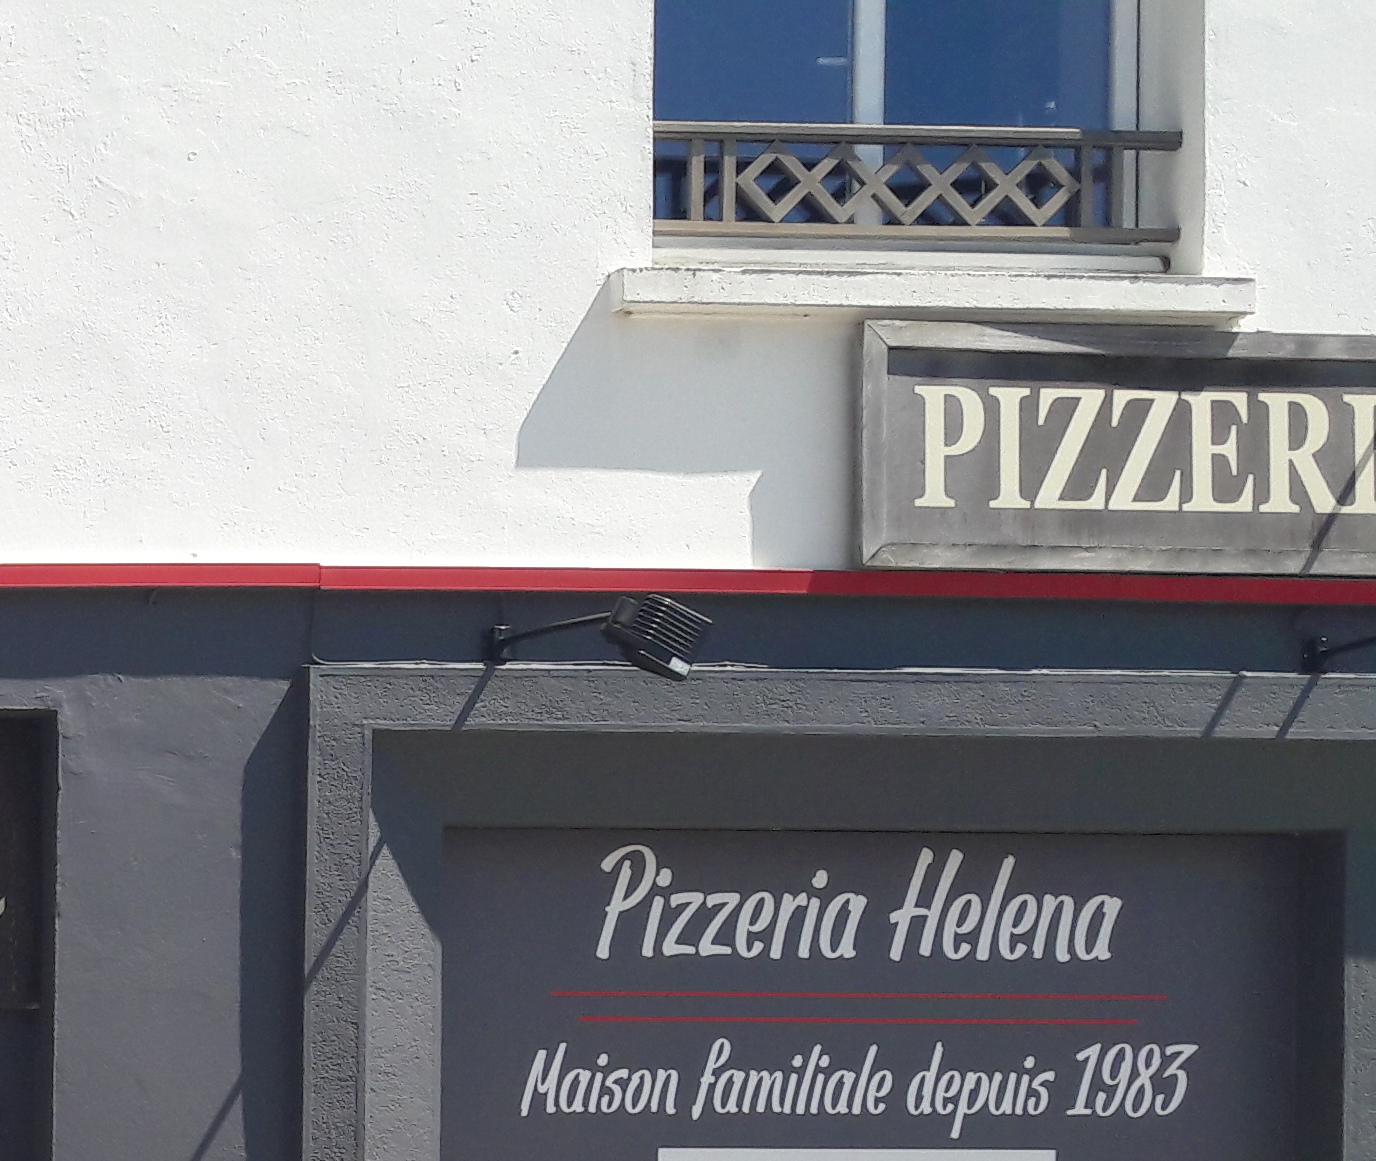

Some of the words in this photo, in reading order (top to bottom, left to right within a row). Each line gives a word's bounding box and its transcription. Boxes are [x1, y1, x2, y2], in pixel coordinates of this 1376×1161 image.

[595, 844, 868, 960] Pizzeria
[888, 847, 1123, 963] Helena
[520, 1042, 678, 1117] Maison
[691, 1037, 893, 1121] familiale
[906, 1041, 1056, 1140] depuis
[1065, 1042, 1199, 1119] 1983
